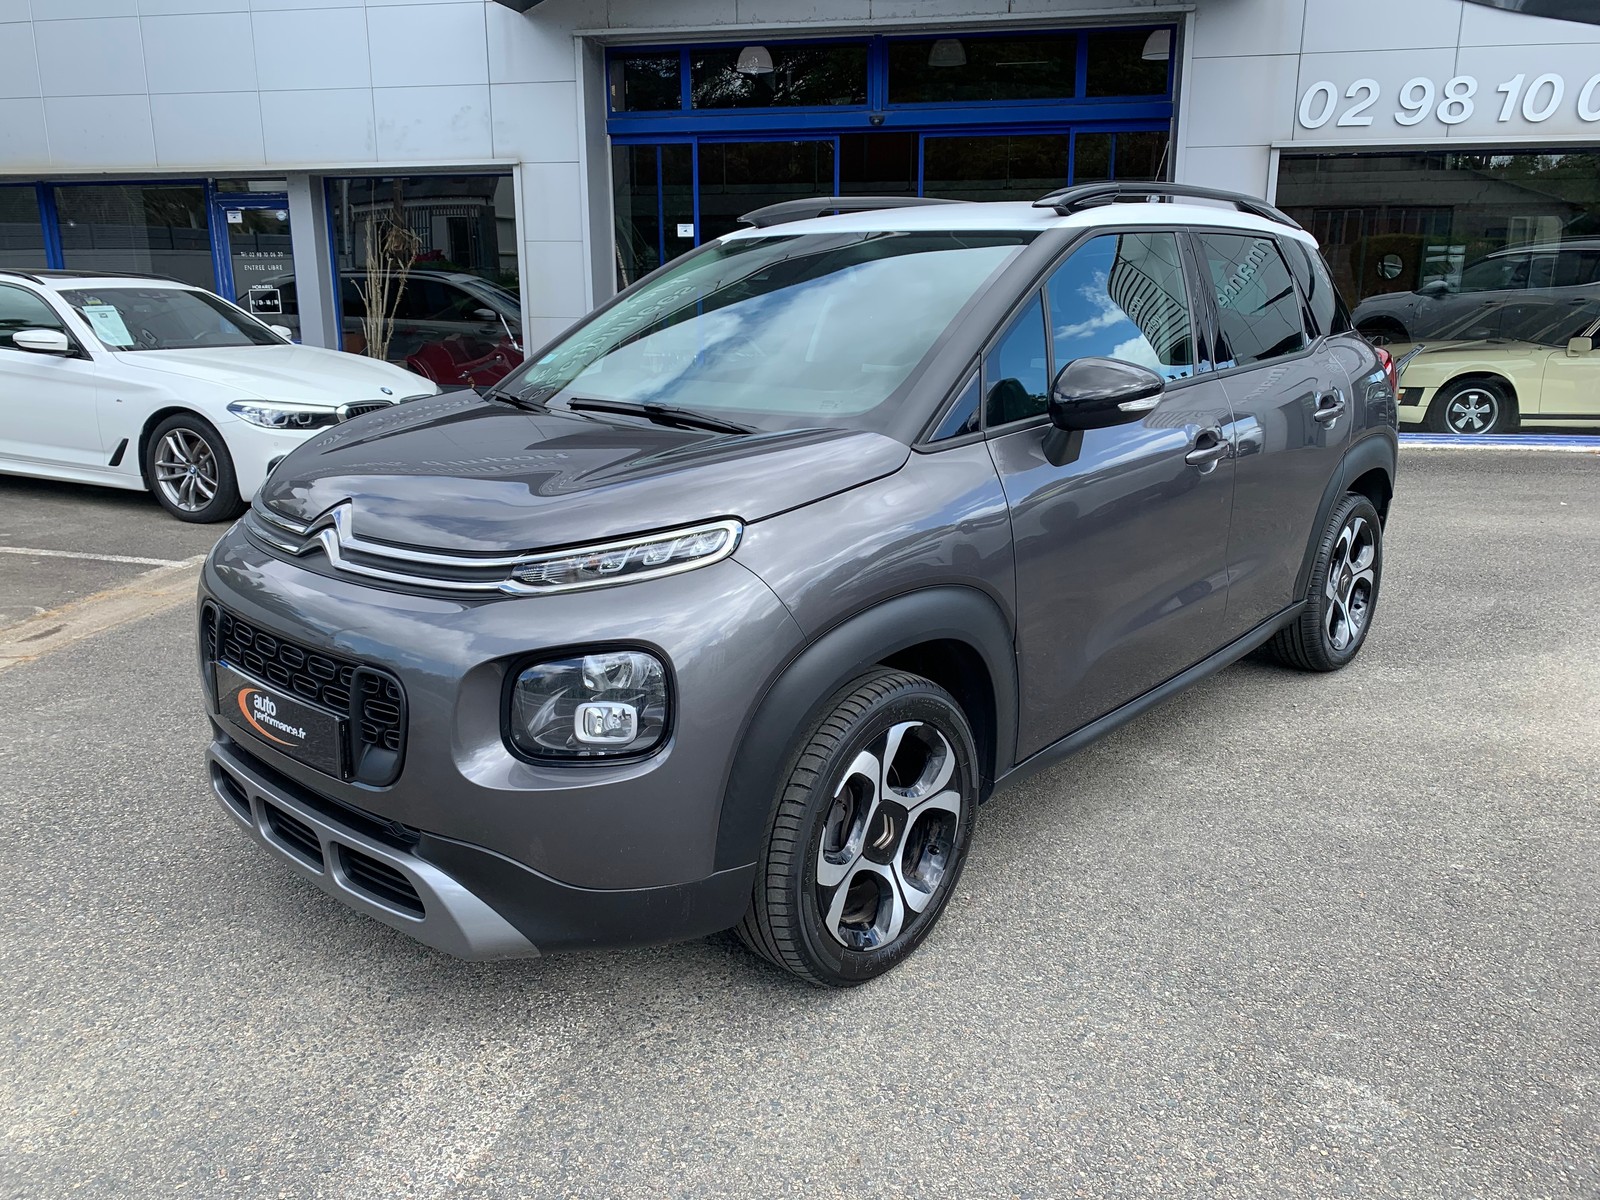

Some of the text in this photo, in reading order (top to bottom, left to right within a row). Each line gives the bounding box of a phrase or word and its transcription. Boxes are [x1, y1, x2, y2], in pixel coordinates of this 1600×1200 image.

[1298, 79, 1381, 129] 02
[1394, 76, 1479, 126] 98
[1497, 73, 1565, 123] 10
[253, 694, 277, 717] auto
[253, 709, 307, 740] performance.fr
